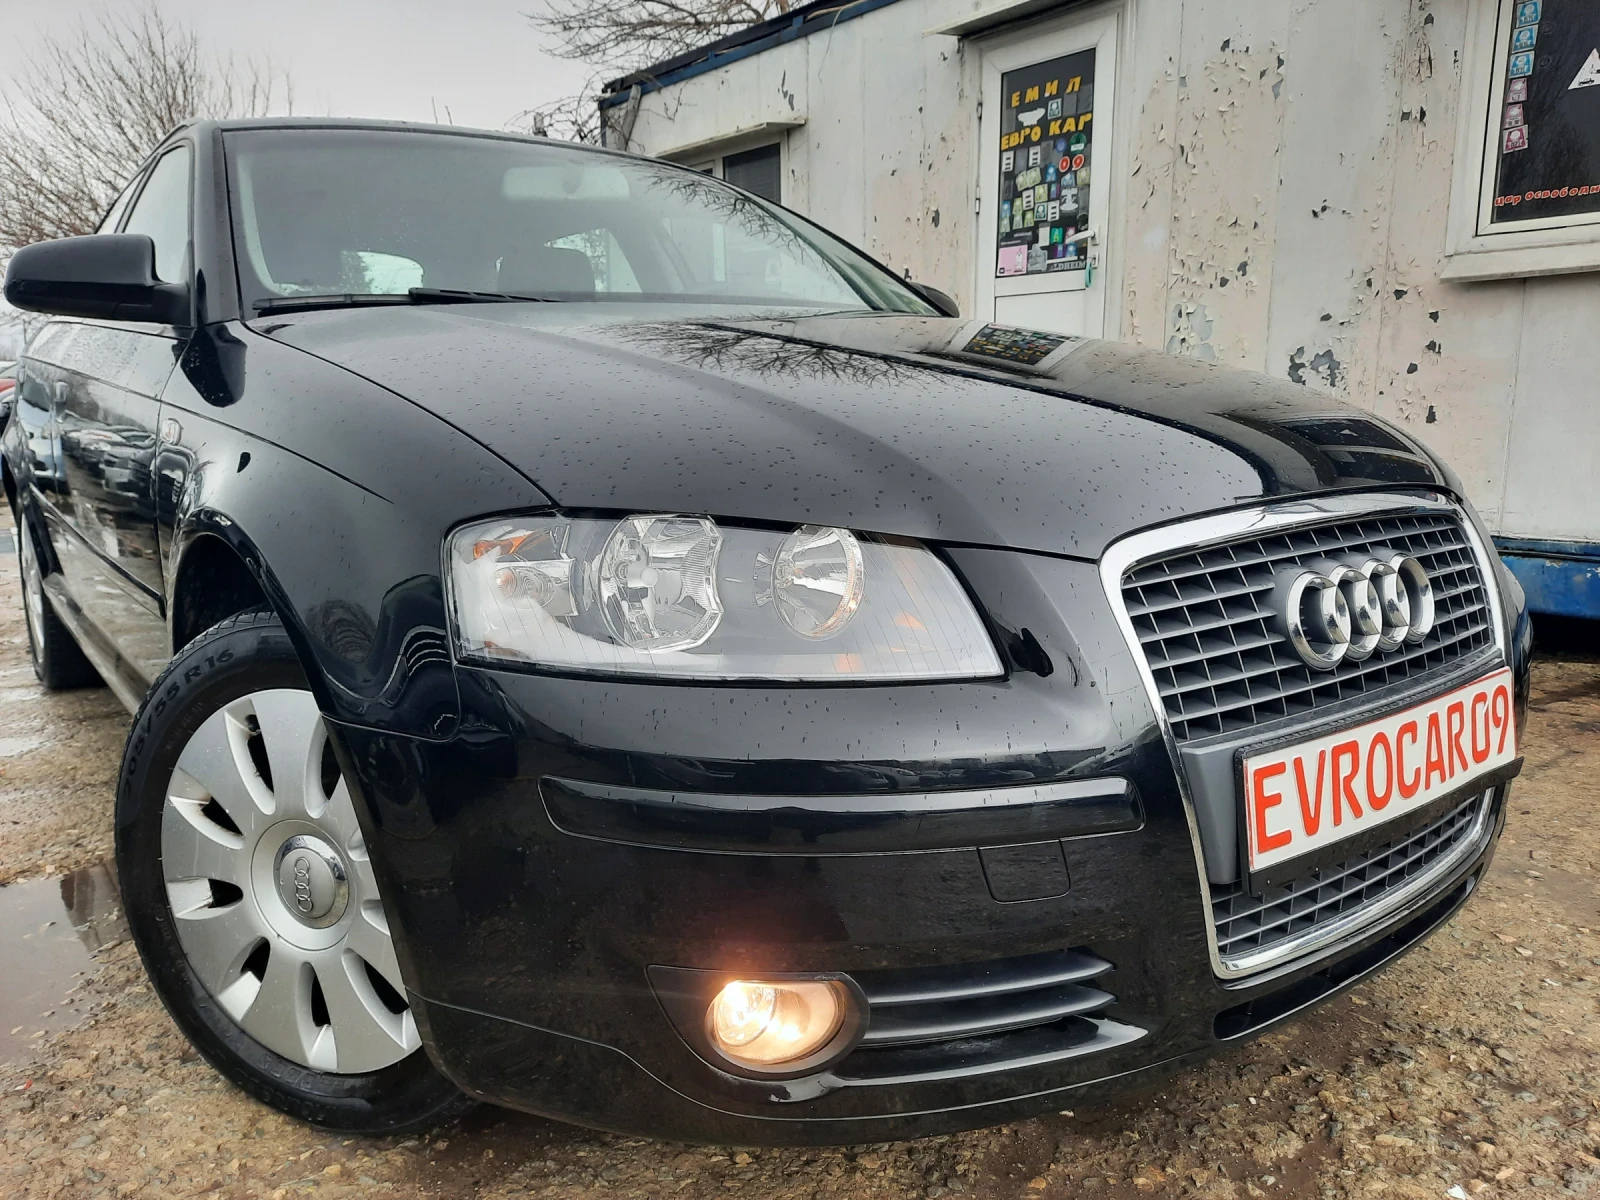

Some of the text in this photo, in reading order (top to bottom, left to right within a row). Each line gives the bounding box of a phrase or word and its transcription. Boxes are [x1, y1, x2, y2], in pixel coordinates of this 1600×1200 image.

[1011, 76, 1081, 107] ЕМИЛ
[1001, 126, 1042, 151] ЕВРО
[1252, 684, 1510, 855] EVROCAR09
